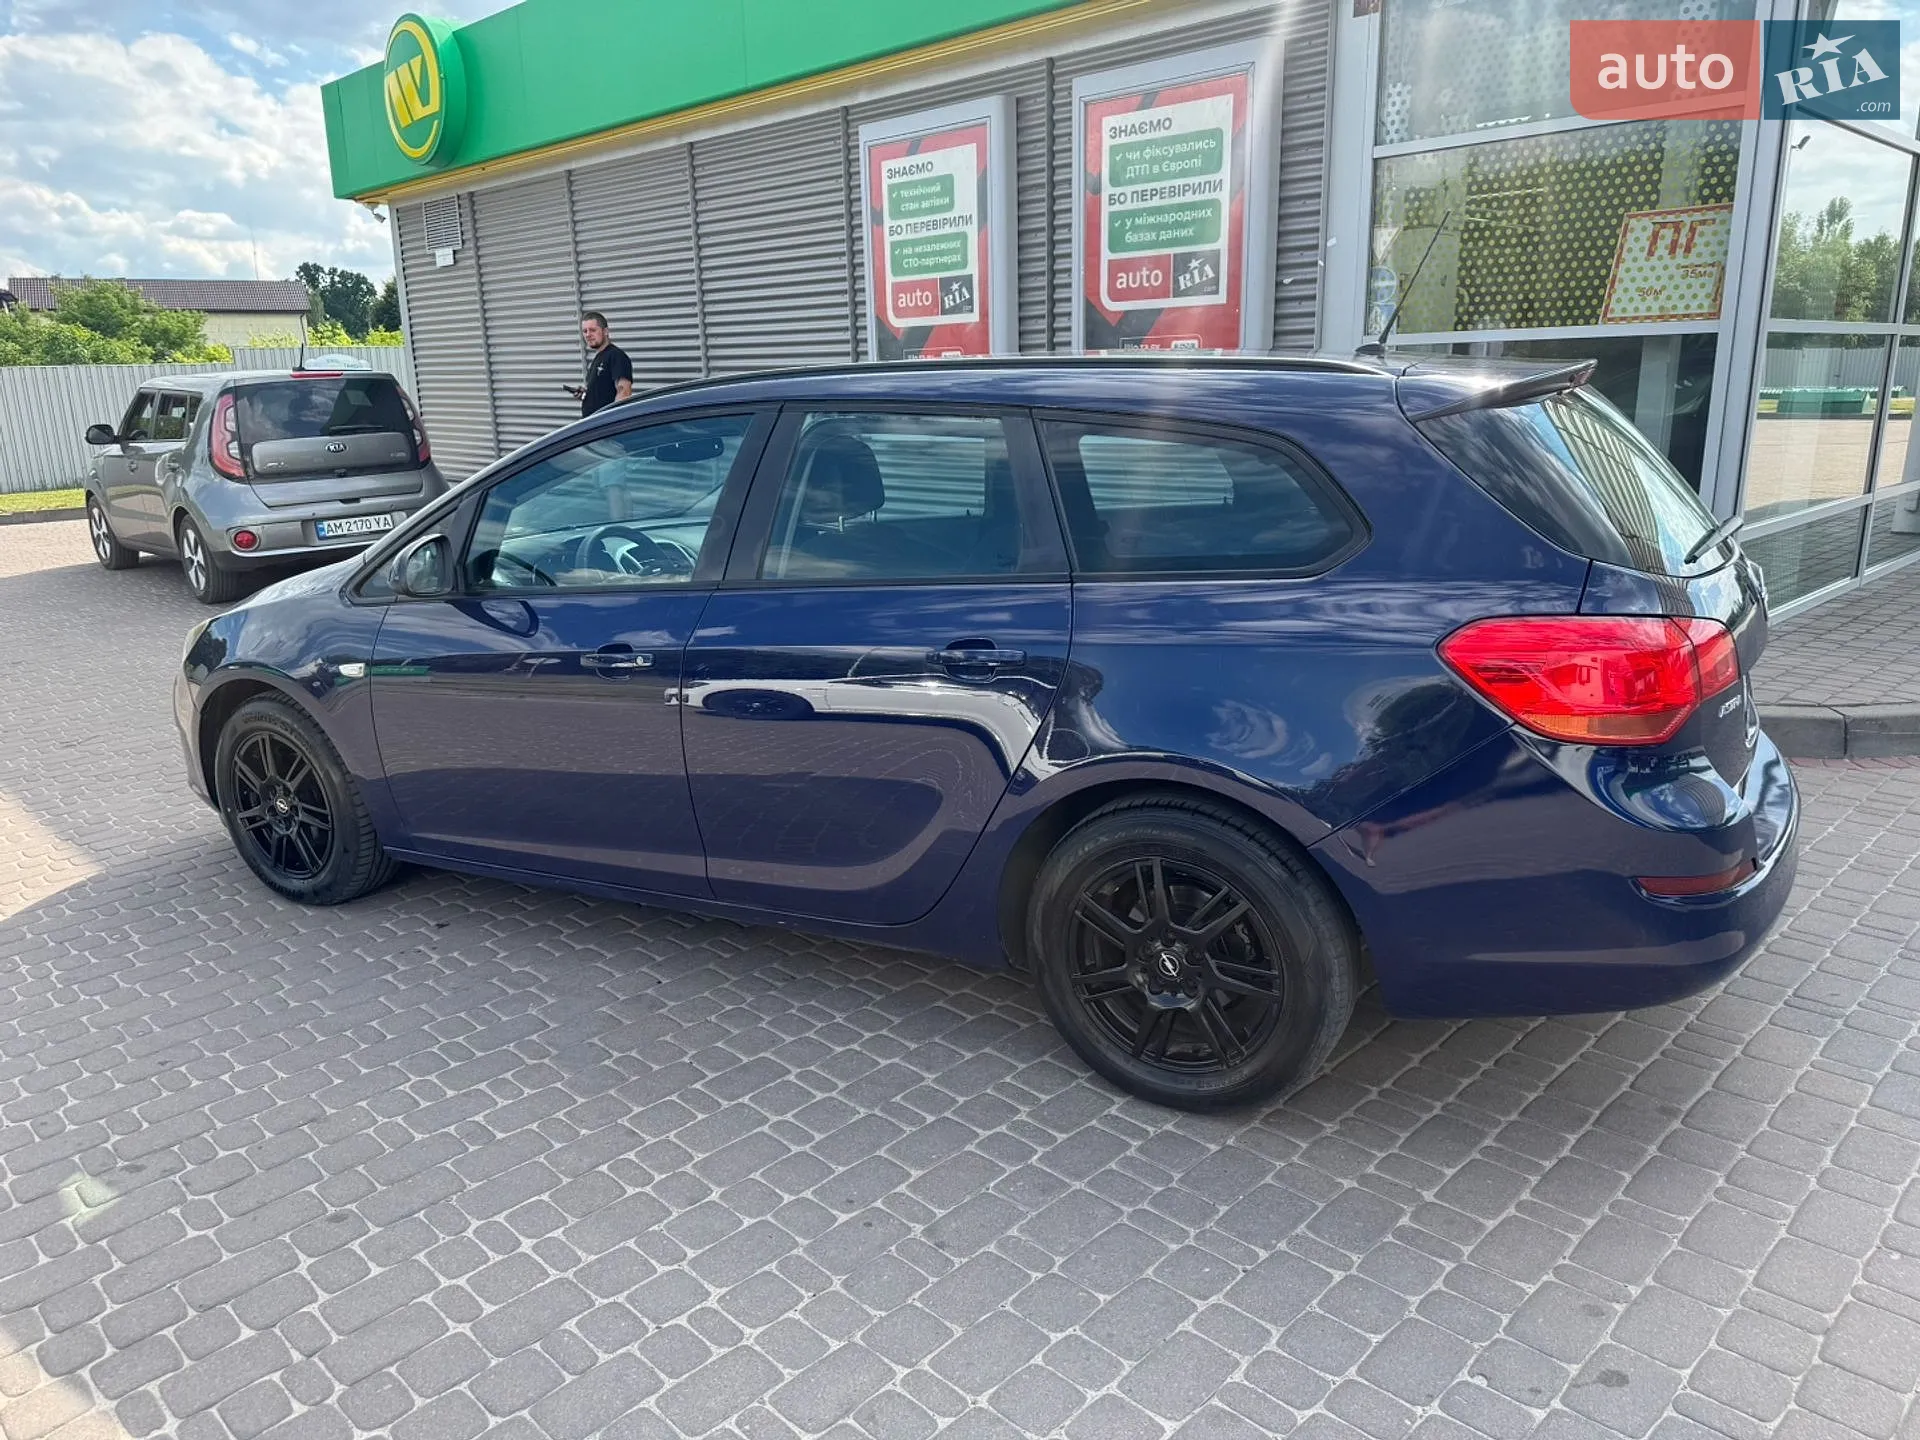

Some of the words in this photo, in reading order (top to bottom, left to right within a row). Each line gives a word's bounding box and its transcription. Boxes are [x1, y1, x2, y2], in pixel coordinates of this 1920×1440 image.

[1108, 117, 1172, 140] ЗНАЄМО
[1125, 150, 1140, 160] чи
[1142, 138, 1217, 160] фіксувались
[886, 161, 934, 180] ЗНАЄМО
[1125, 164, 1150, 179] ДТП
[1152, 164, 1159, 174] в
[1162, 154, 1202, 172] Європі
[1108, 192, 1128, 206] БО
[1130, 179, 1223, 203] ПЕРЕВІРИЛИ
[888, 224, 903, 237] БО
[905, 214, 973, 234] ПЕРЕВІРИЛИ
[1124, 218, 1133, 229] у
[1134, 208, 1213, 225] міжнародних
[1124, 231, 1157, 243] базах
[1158, 226, 1194, 241] даних
[1116, 267, 1163, 289] auto
[1178, 263, 1216, 291] RIA
[897, 287, 932, 308] auto
[943, 285, 970, 309] RIA
[345, 518, 372, 532] 2170
